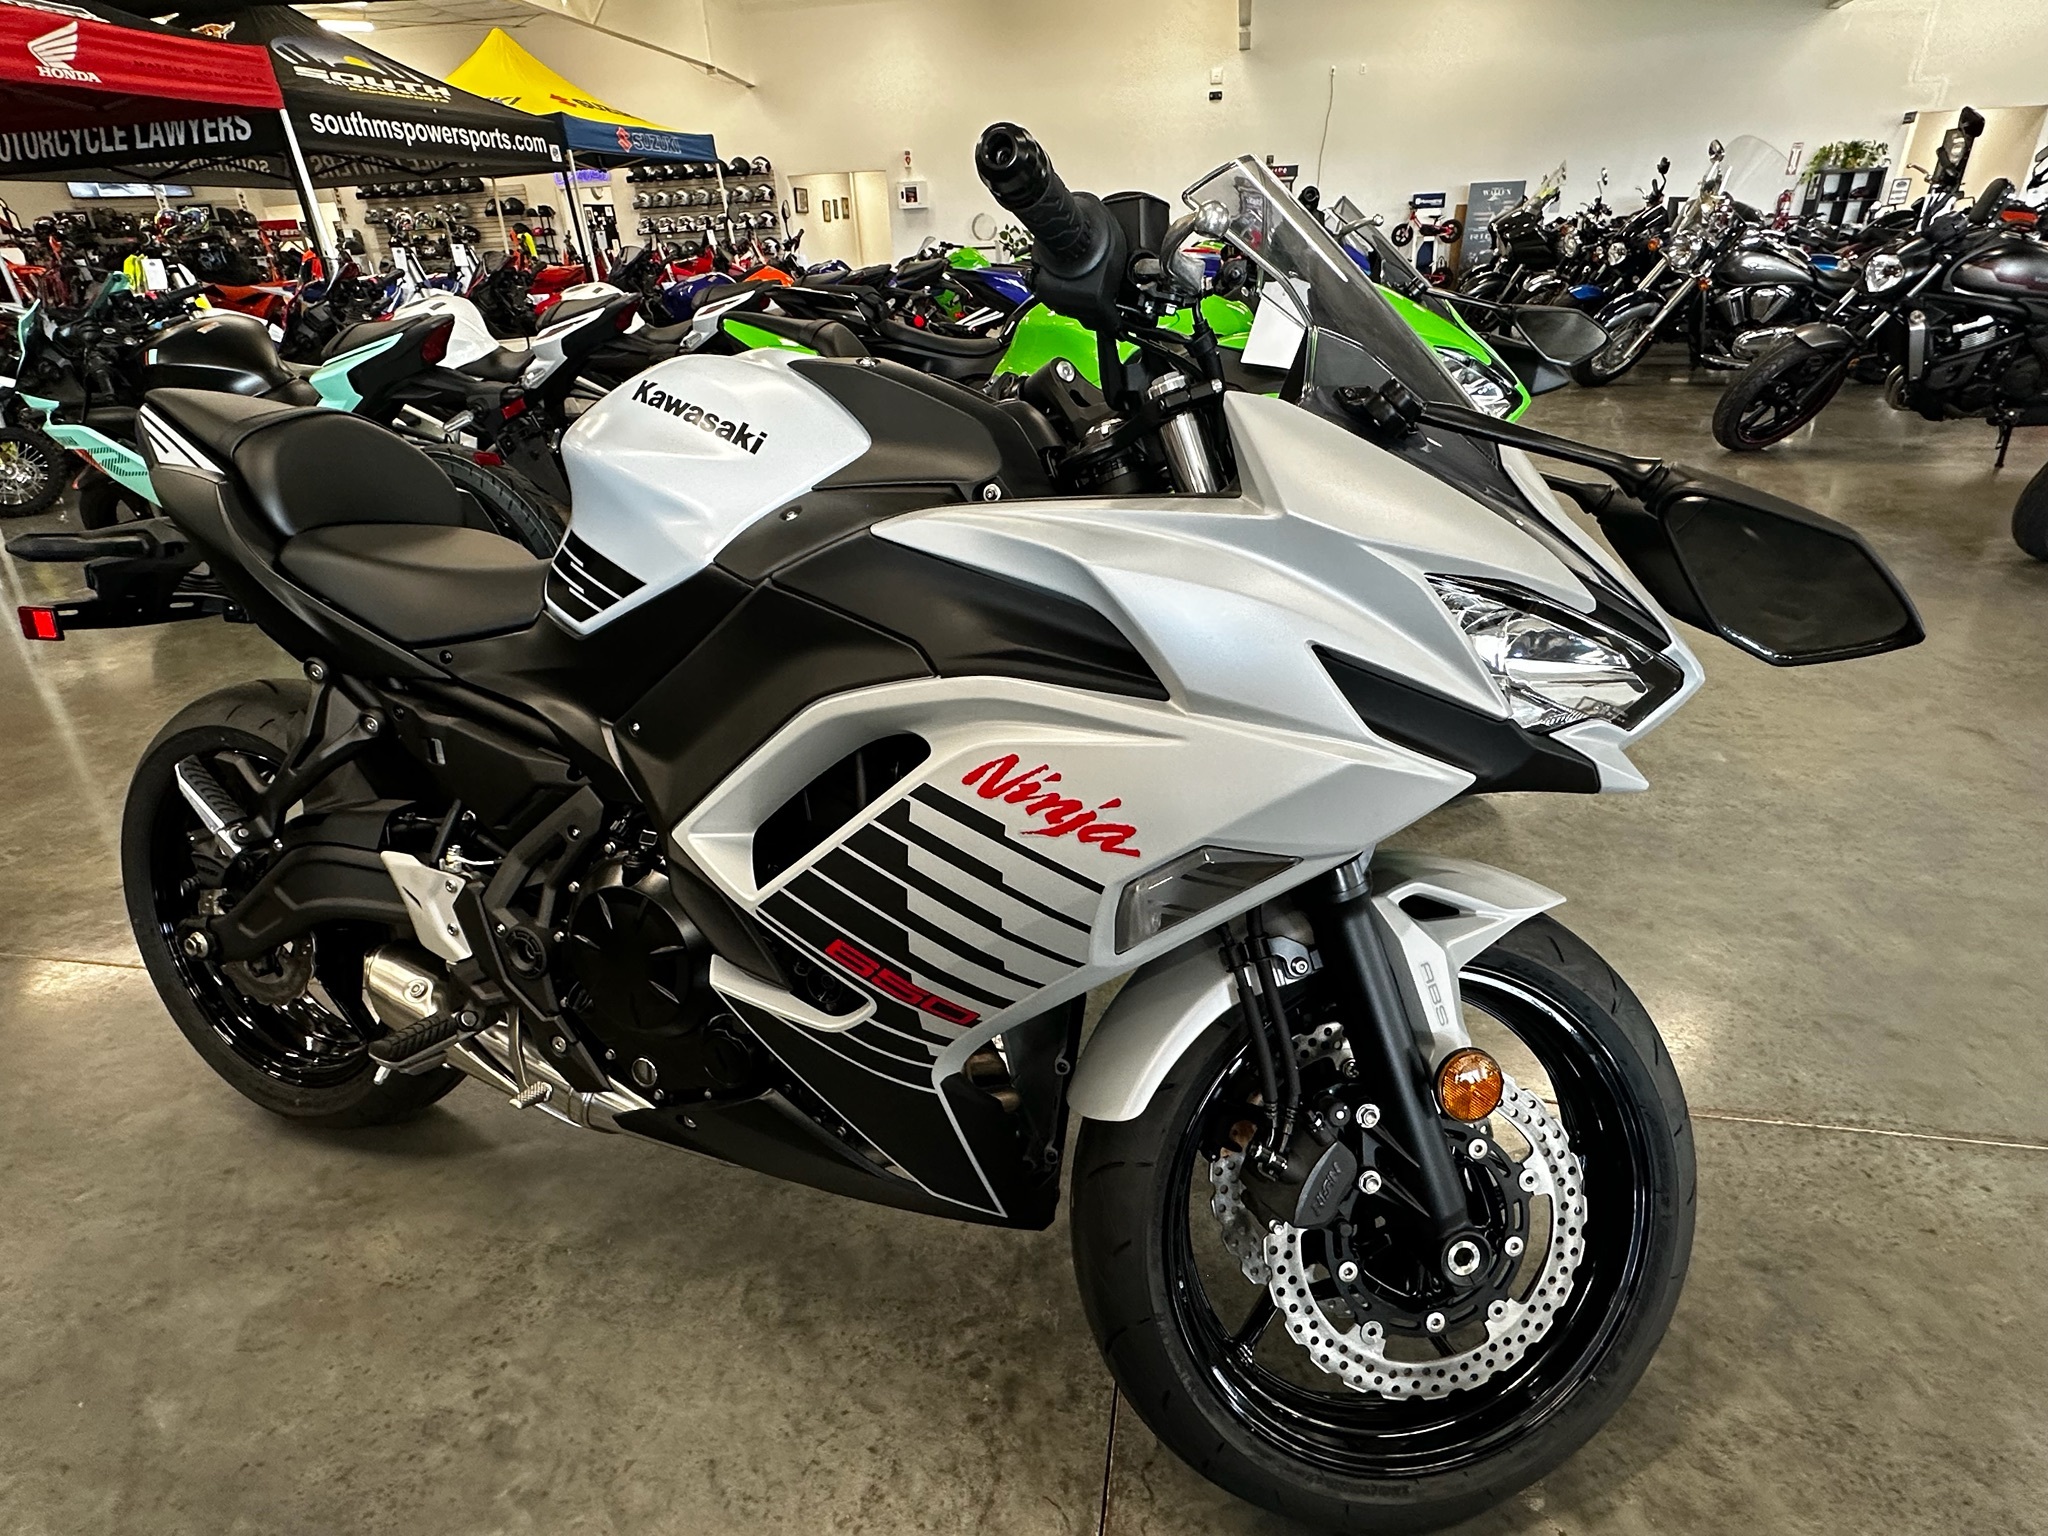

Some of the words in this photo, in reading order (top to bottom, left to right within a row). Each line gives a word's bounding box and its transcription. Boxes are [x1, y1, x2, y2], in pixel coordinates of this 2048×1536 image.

[35, 64, 102, 84] HONDA
[293, 65, 451, 99] SOUTH
[134, 114, 252, 150] LAWYERS
[309, 111, 548, 155] southmspowersports.com
[631, 132, 682, 155] SUZUKI
[631, 379, 768, 455] Kawasaki
[961, 753, 1141, 858] Ninja
[824, 938, 981, 1026] 650
[1420, 961, 1449, 1027] ABS
